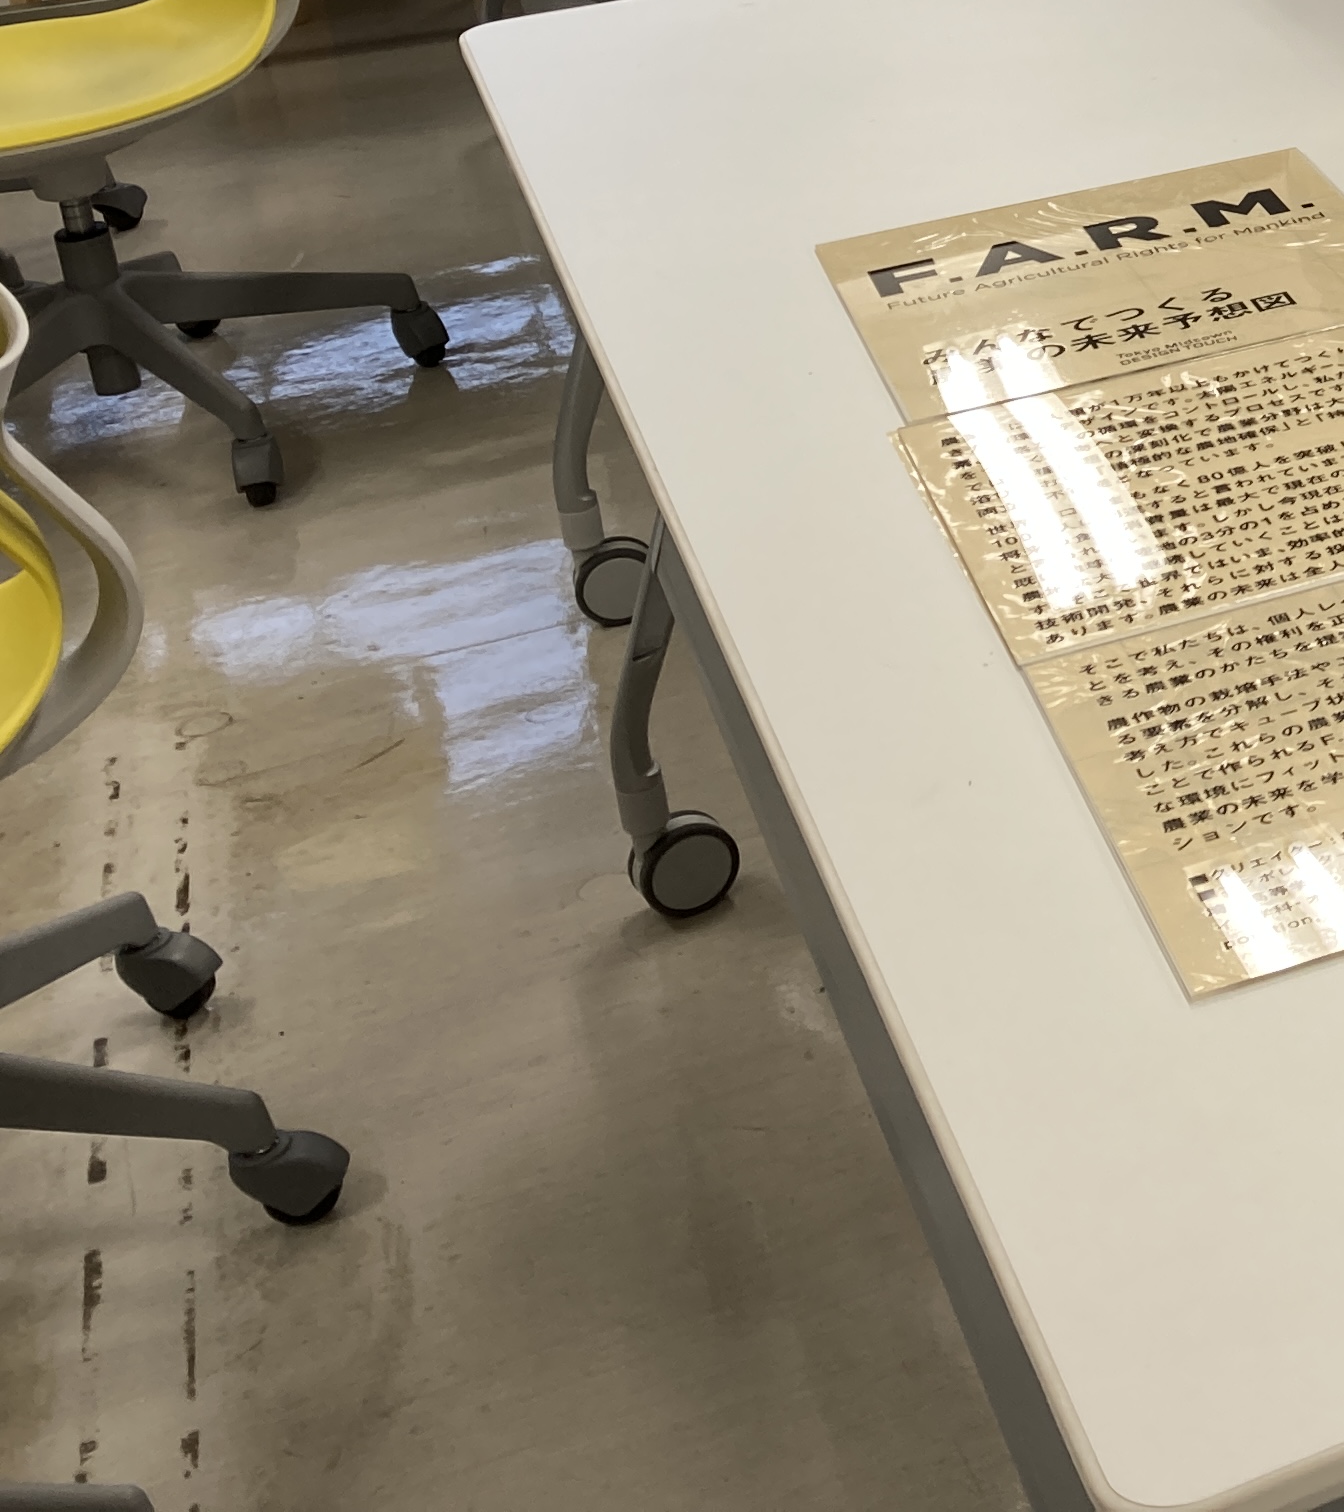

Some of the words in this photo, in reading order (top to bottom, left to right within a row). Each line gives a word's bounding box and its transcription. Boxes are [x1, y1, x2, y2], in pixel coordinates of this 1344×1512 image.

[866, 182, 1315, 298] F.A.R.M.
[885, 286, 967, 310] Future
[971, 256, 1111, 292] Agricultural
[1114, 239, 1190, 262] Rights
[1192, 231, 1228, 245] for
[1230, 210, 1327, 237] Mankind
[924, 290, 1298, 385] の未来予想図
[1115, 344, 1162, 360] Tokyo
[1163, 328, 1234, 349] Midtown
[1117, 346, 1182, 366] DESIGN
[1182, 334, 1239, 352] TOUCH
[1170, 797, 1320, 852] ションです。
